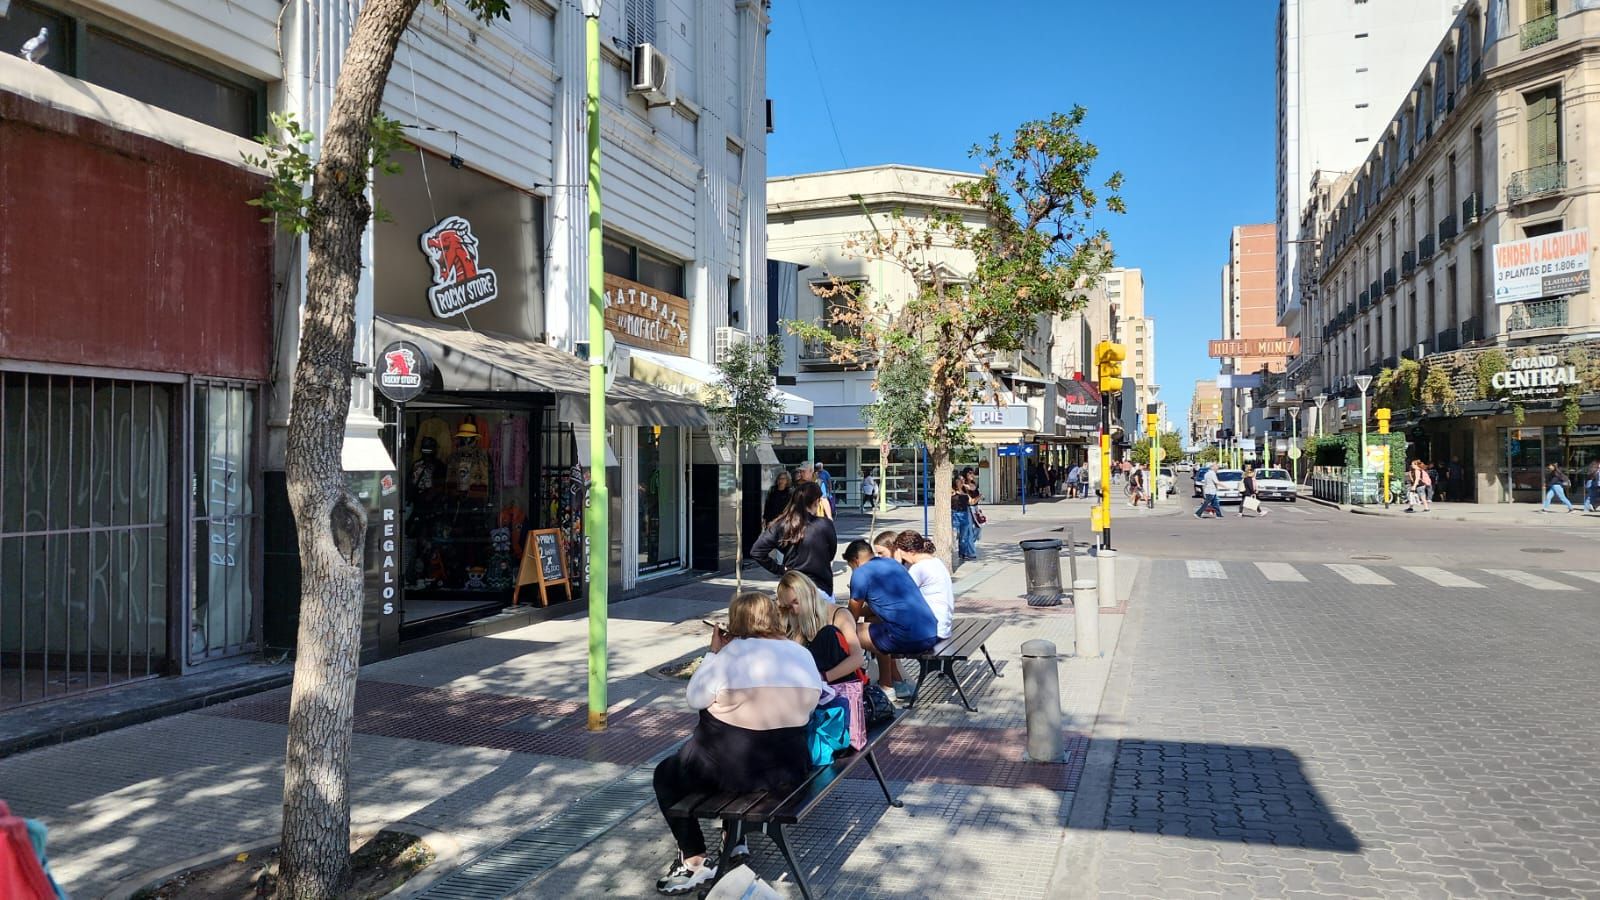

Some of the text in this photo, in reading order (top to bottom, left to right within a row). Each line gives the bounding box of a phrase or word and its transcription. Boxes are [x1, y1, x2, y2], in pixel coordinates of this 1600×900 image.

[1496, 242, 1531, 268] VENDEN
[1542, 231, 1589, 261] ALQUILAN
[1498, 272, 1504, 281] 3
[1505, 265, 1540, 279] PLANTAS
[1541, 263, 1552, 274] DE
[1555, 260, 1576, 272] 1.806
[436, 275, 495, 311] ROCKY STORE
[603, 288, 677, 329] NATURAL
[1214, 342, 1248, 354] HOTEL
[1511, 355, 1558, 370] GRAND
[400, 374, 418, 384] STORE
[1491, 365, 1582, 389] CENTRAL
[981, 411, 1004, 423] PIE
[383, 508, 395, 615] REGALOS
